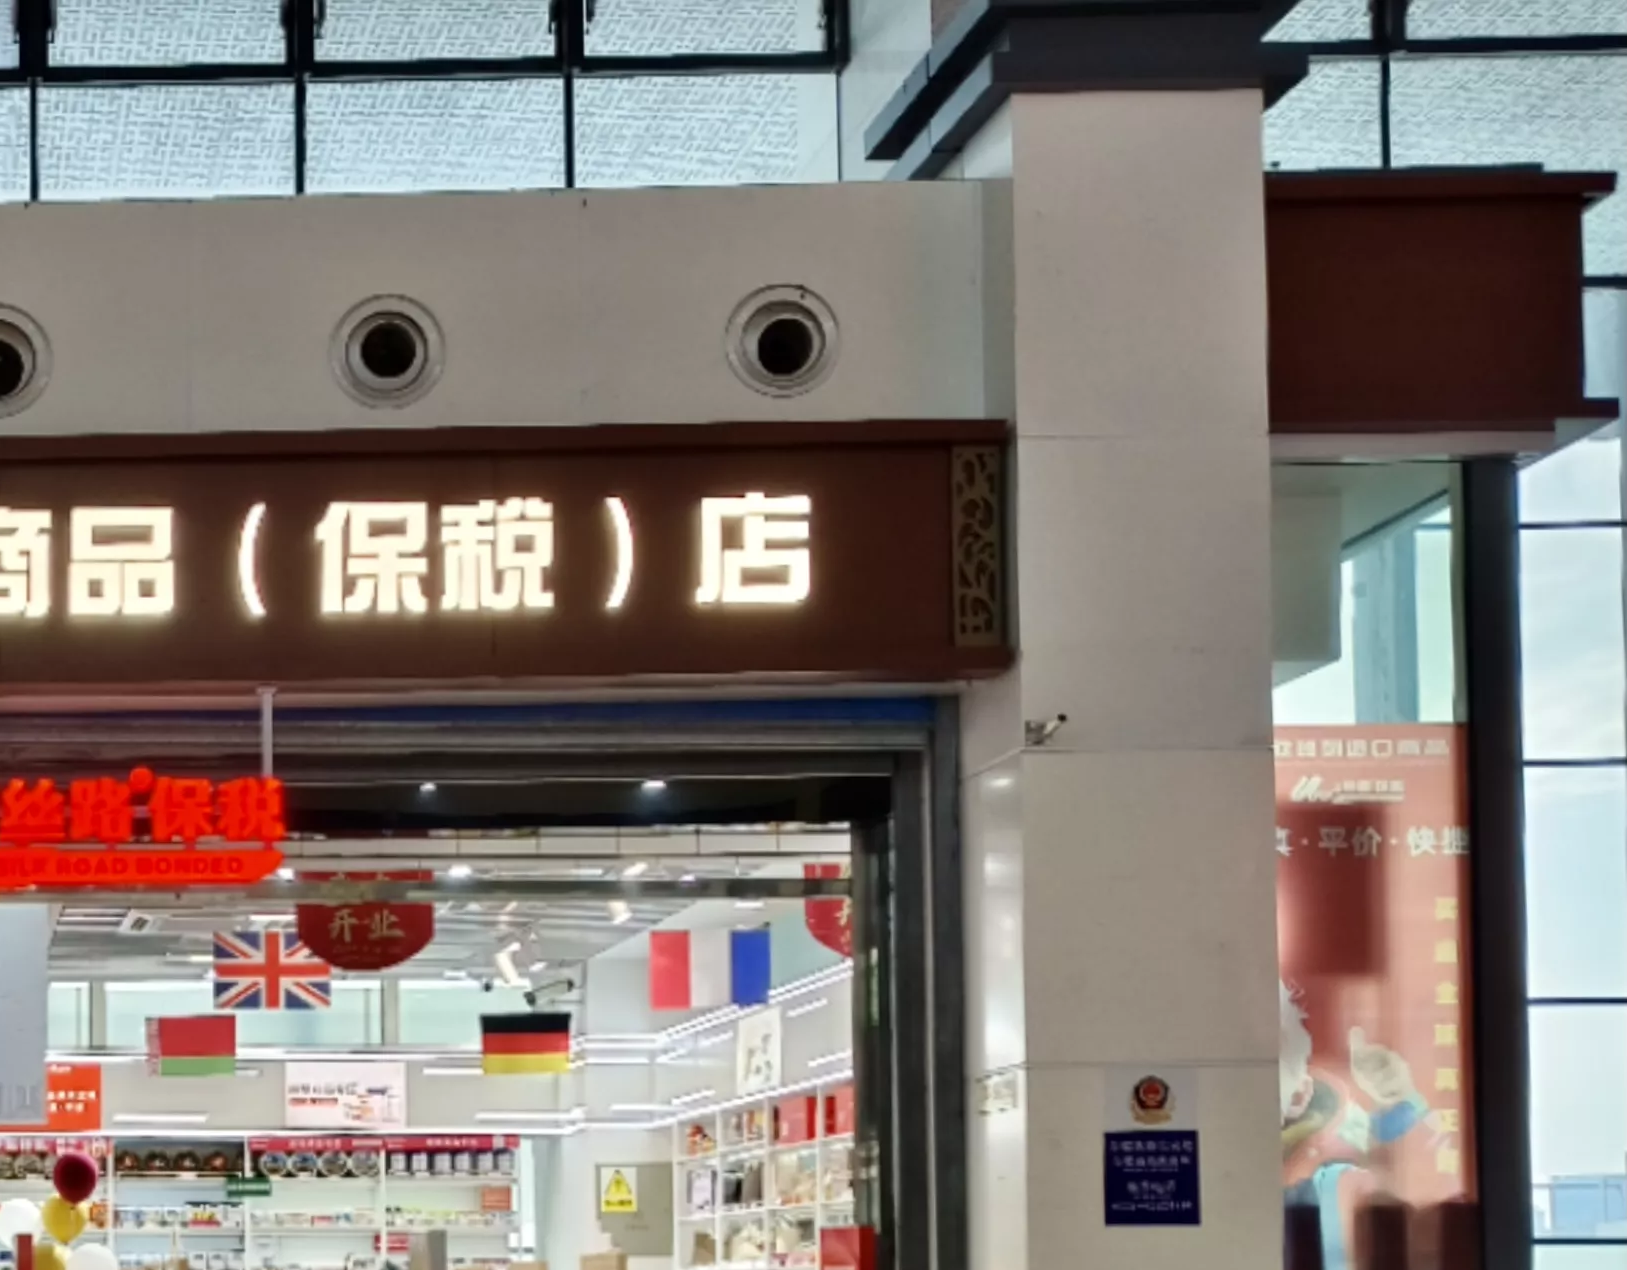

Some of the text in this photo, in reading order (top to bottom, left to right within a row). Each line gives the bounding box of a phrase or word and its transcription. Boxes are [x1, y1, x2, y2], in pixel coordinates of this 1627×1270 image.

[56, 857, 127, 875] ROAD
[133, 856, 244, 875] BONDED
[328, 908, 405, 943] 开业
